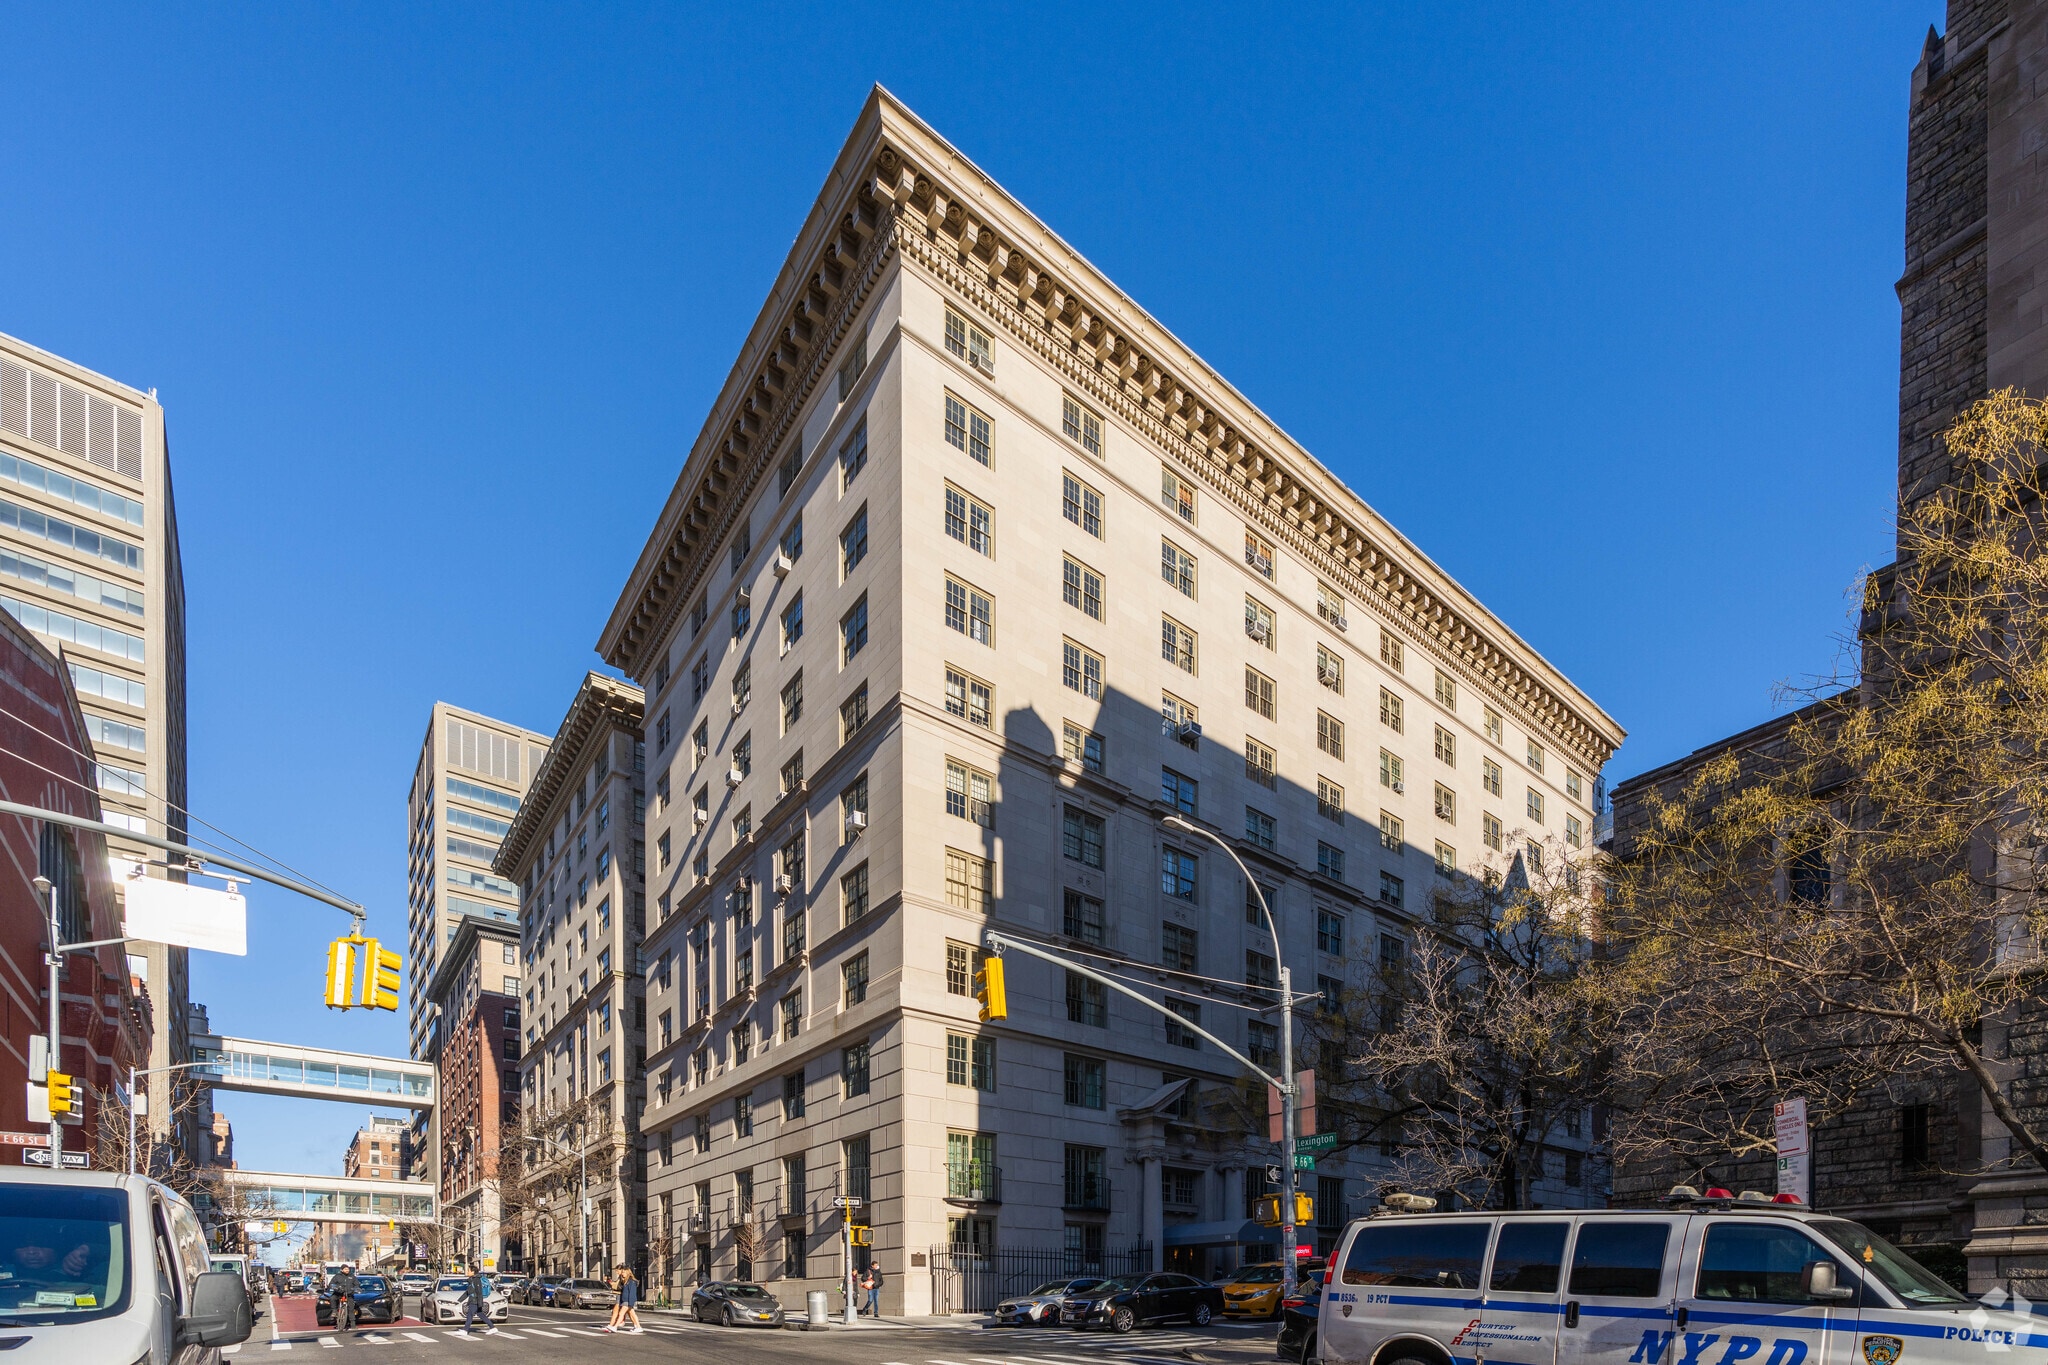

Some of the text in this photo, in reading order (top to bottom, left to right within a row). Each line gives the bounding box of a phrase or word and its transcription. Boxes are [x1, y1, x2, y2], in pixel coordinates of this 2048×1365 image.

[1777, 1105, 1782, 1115] 3
[4, 1135, 38, 1144] E 66 St
[1297, 1135, 1334, 1147] Lexington
[34, 1153, 53, 1161] ONE
[1294, 1156, 1298, 1167] E
[1300, 1156, 1308, 1168] 66
[1780, 1160, 1786, 1170] 2
[1341, 1293, 1356, 1303] 8536
[1367, 1294, 1388, 1304] 19 PCT
[1468, 1319, 1516, 1330] COURTESY
[1459, 1328, 1541, 1342] PROFESSIONALISM
[1946, 1326, 2016, 1345] POLICE
[1450, 1336, 1493, 1348] RESPECT
[1628, 1330, 1809, 1365] NYPD
